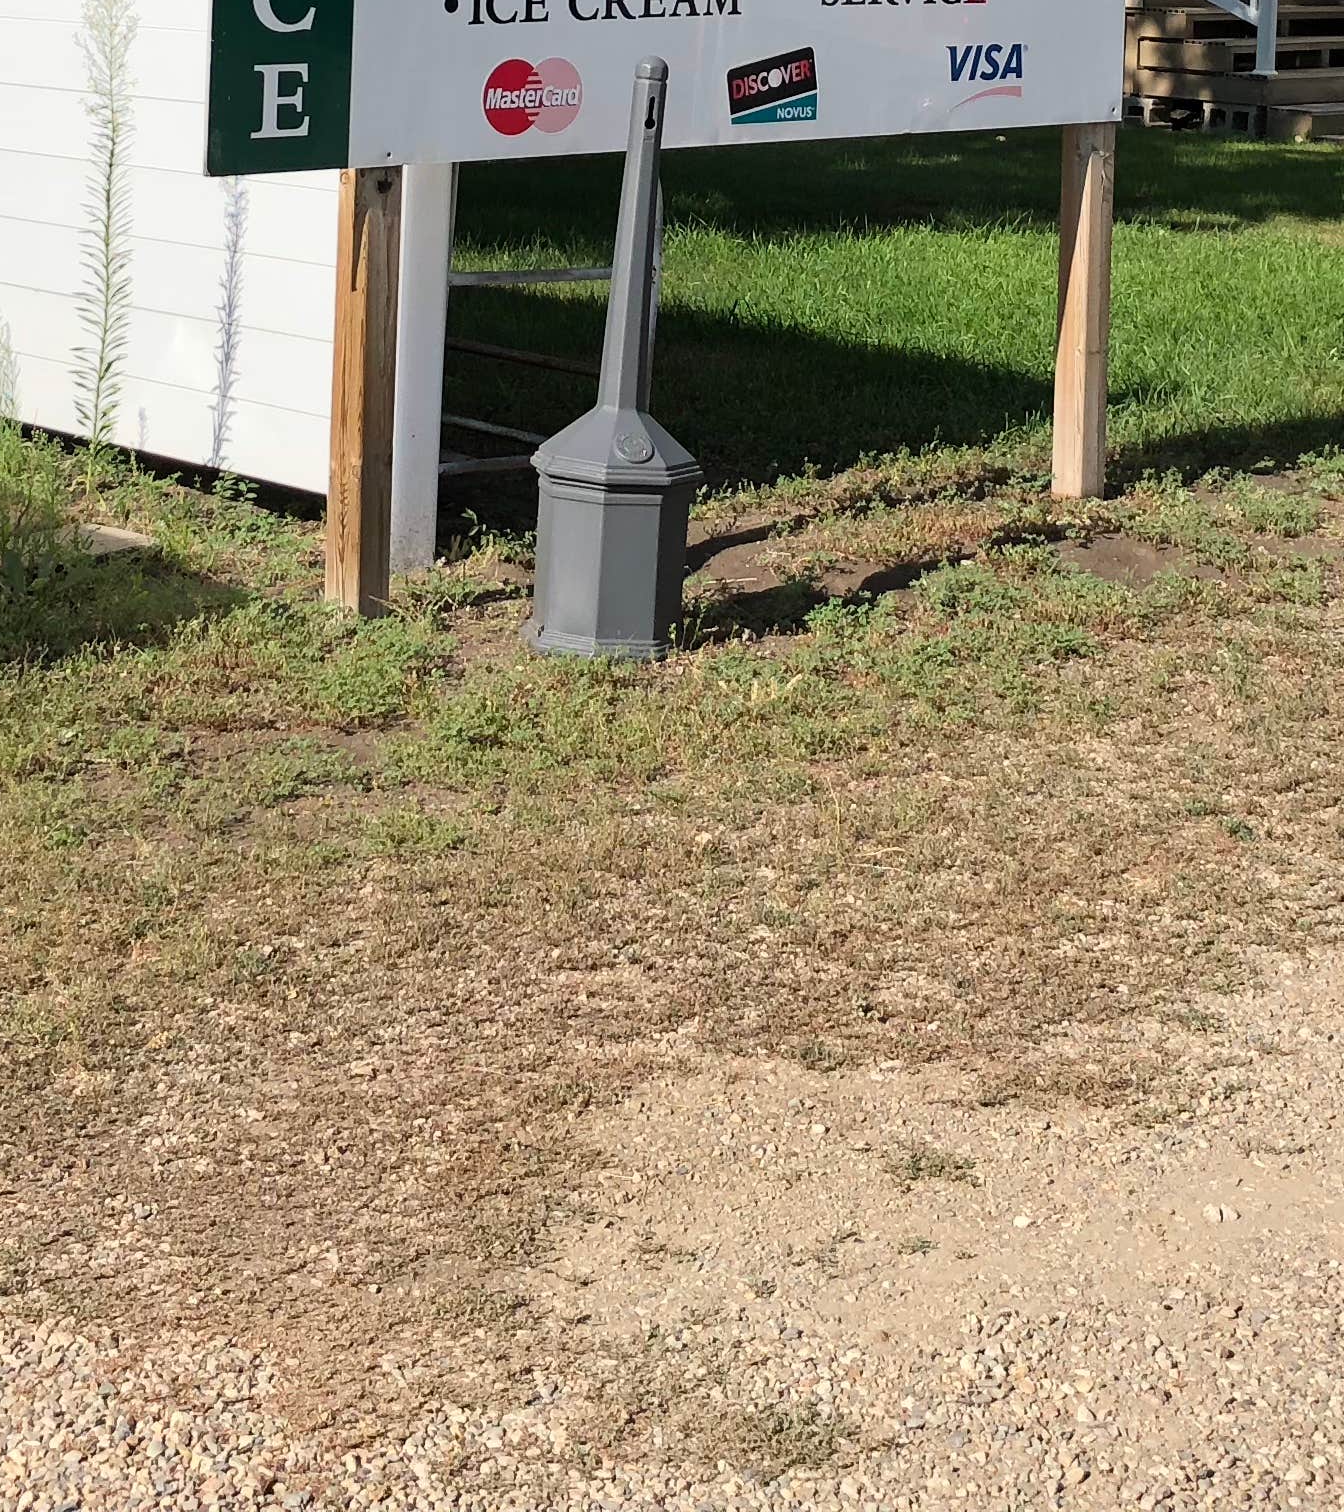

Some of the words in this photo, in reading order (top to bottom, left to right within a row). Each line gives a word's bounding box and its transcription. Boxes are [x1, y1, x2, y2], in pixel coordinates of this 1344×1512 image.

[946, 43, 1023, 82] VISA
[732, 59, 811, 100] DISCOVER
[485, 84, 580, 109] MasterCard
[777, 106, 812, 119] NOVUS
